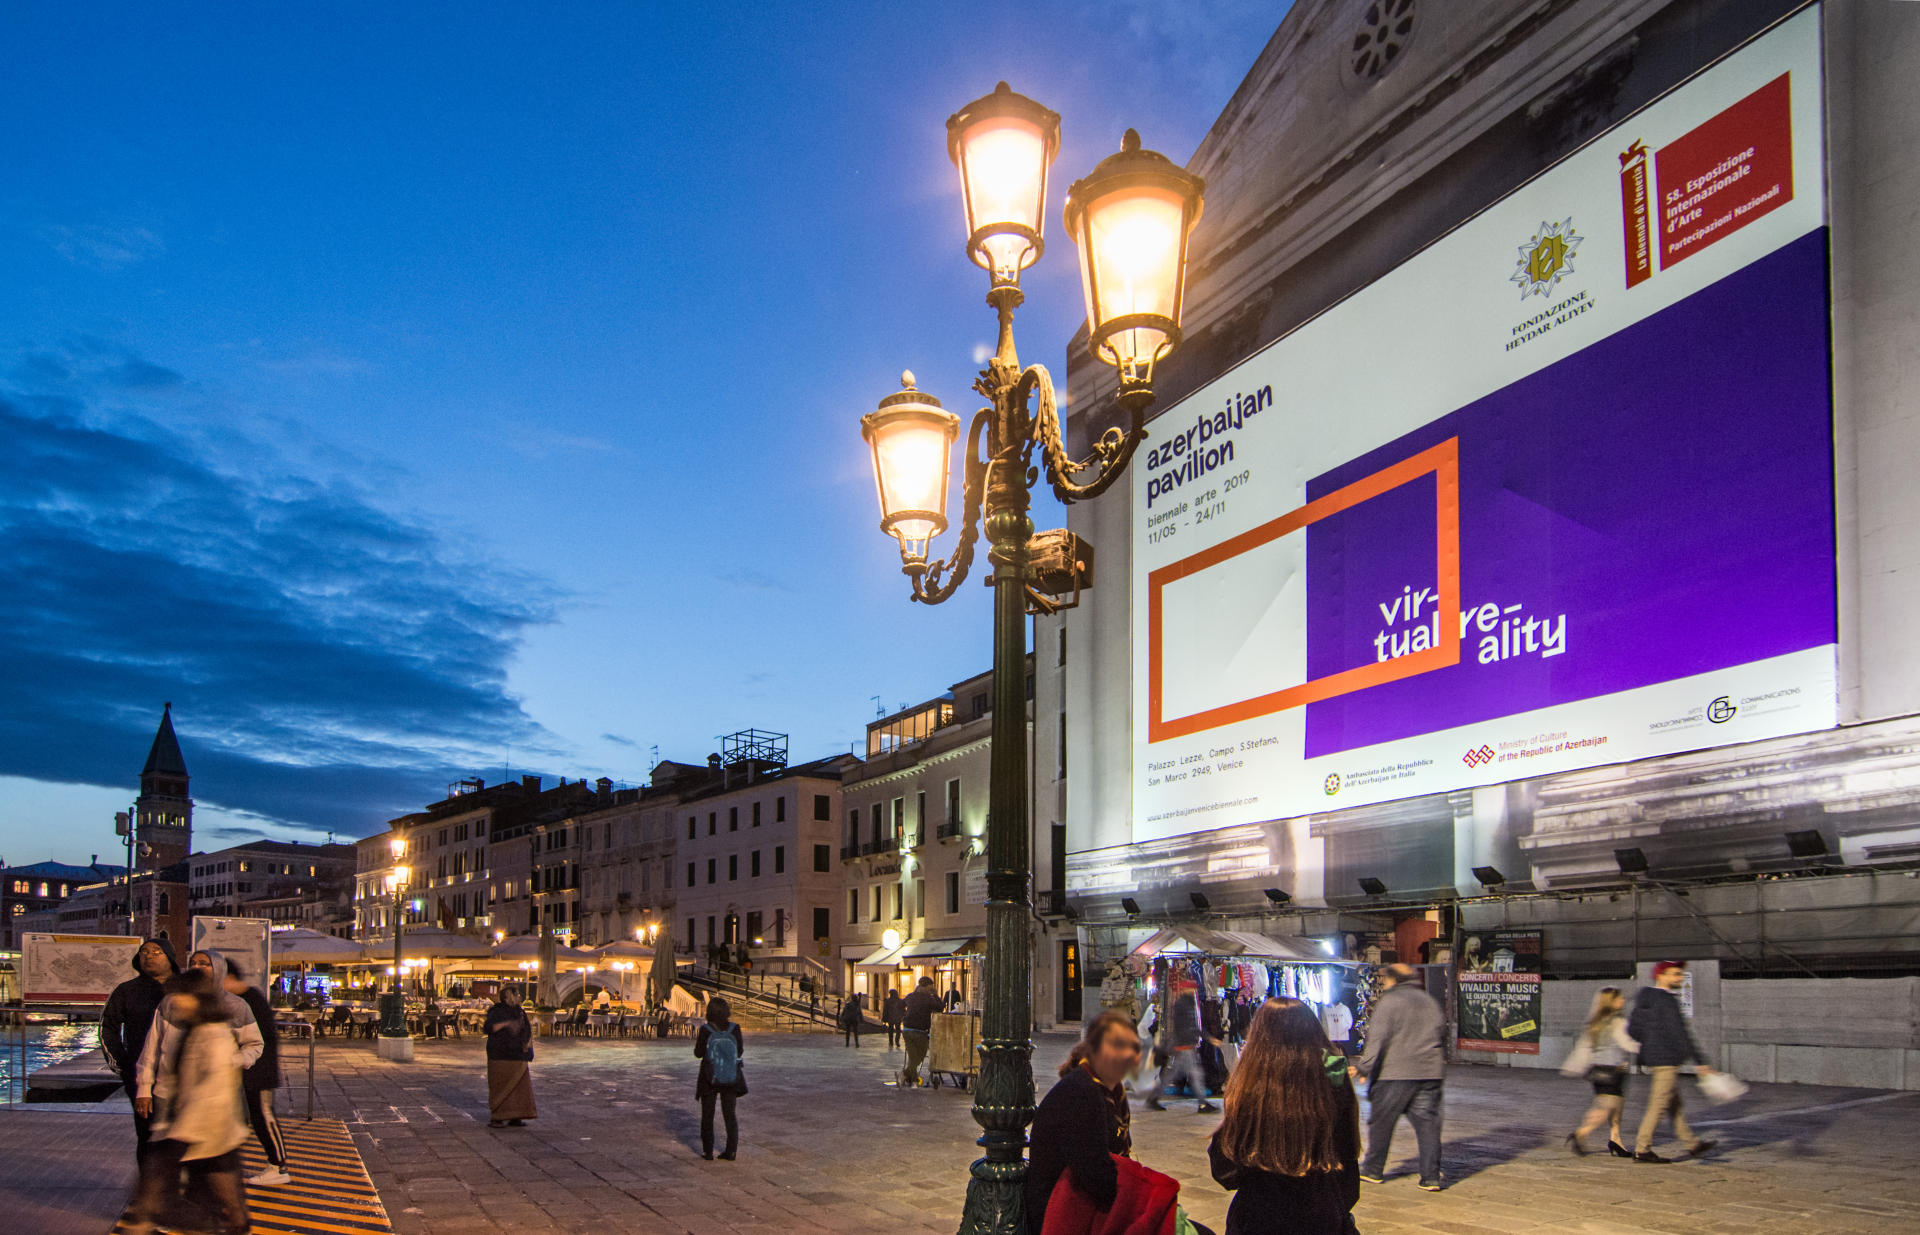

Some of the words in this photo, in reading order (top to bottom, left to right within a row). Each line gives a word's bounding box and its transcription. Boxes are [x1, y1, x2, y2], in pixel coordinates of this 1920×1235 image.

[1633, 165, 1644, 205] Venezia
[1666, 188, 1684, 205] 58.
[1686, 146, 1755, 193] Esposizione
[1666, 163, 1751, 219] Internazionale
[1634, 203, 1645, 215] di
[1669, 211, 1733, 254] Partecipazioni
[1734, 184, 1780, 218] Nazionali
[1635, 215, 1647, 259] Biennale
[1505, 322, 1551, 352] HEYDAR
[1554, 298, 1595, 327] ALIYEV
[1512, 290, 1587, 336] FONDAZIONE
[1147, 384, 1273, 471] azerbaijan
[1147, 440, 1234, 509] pavilion
[1147, 502, 1188, 528] biennale
[1194, 489, 1217, 506] arte
[1224, 469, 1250, 493] 2019
[1148, 523, 1176, 544] 11/05
[1196, 501, 1226, 524] 24/11
[1378, 585, 1440, 626] vir-
[1459, 602, 1523, 639] re-
[1373, 610, 1440, 663] tual
[1478, 613, 1566, 665] ality
[1148, 760, 1176, 772] Palazzo
[1180, 753, 1204, 765] Lezze,
[1209, 746, 1235, 758] Campo
[1499, 736, 1528, 751] Ministry
[1530, 735, 1538, 745] of
[1539, 730, 1568, 743] Culture
[1499, 753, 1506, 763] of
[1507, 751, 1519, 760] the
[1520, 746, 1554, 758] Republic
[1556, 743, 1563, 752] of
[1565, 736, 1608, 750] Azerbaijan
[1148, 777, 1160, 787] San
[1165, 771, 1187, 783] Marco
[1192, 765, 1212, 778] 2949,
[1218, 759, 1244, 772] Venice
[1380, 765, 1396, 774] della
[1397, 759, 1434, 771] Repubblica
[1399, 770, 1416, 779] Italia
[1147, 796, 1258, 822] www.azerbaijanvenicebiennale.com
[1460, 983, 1500, 992] VIVALDI'S
[1506, 983, 1539, 993] MUSIC
[1501, 993, 1531, 1001] STAGIONI
